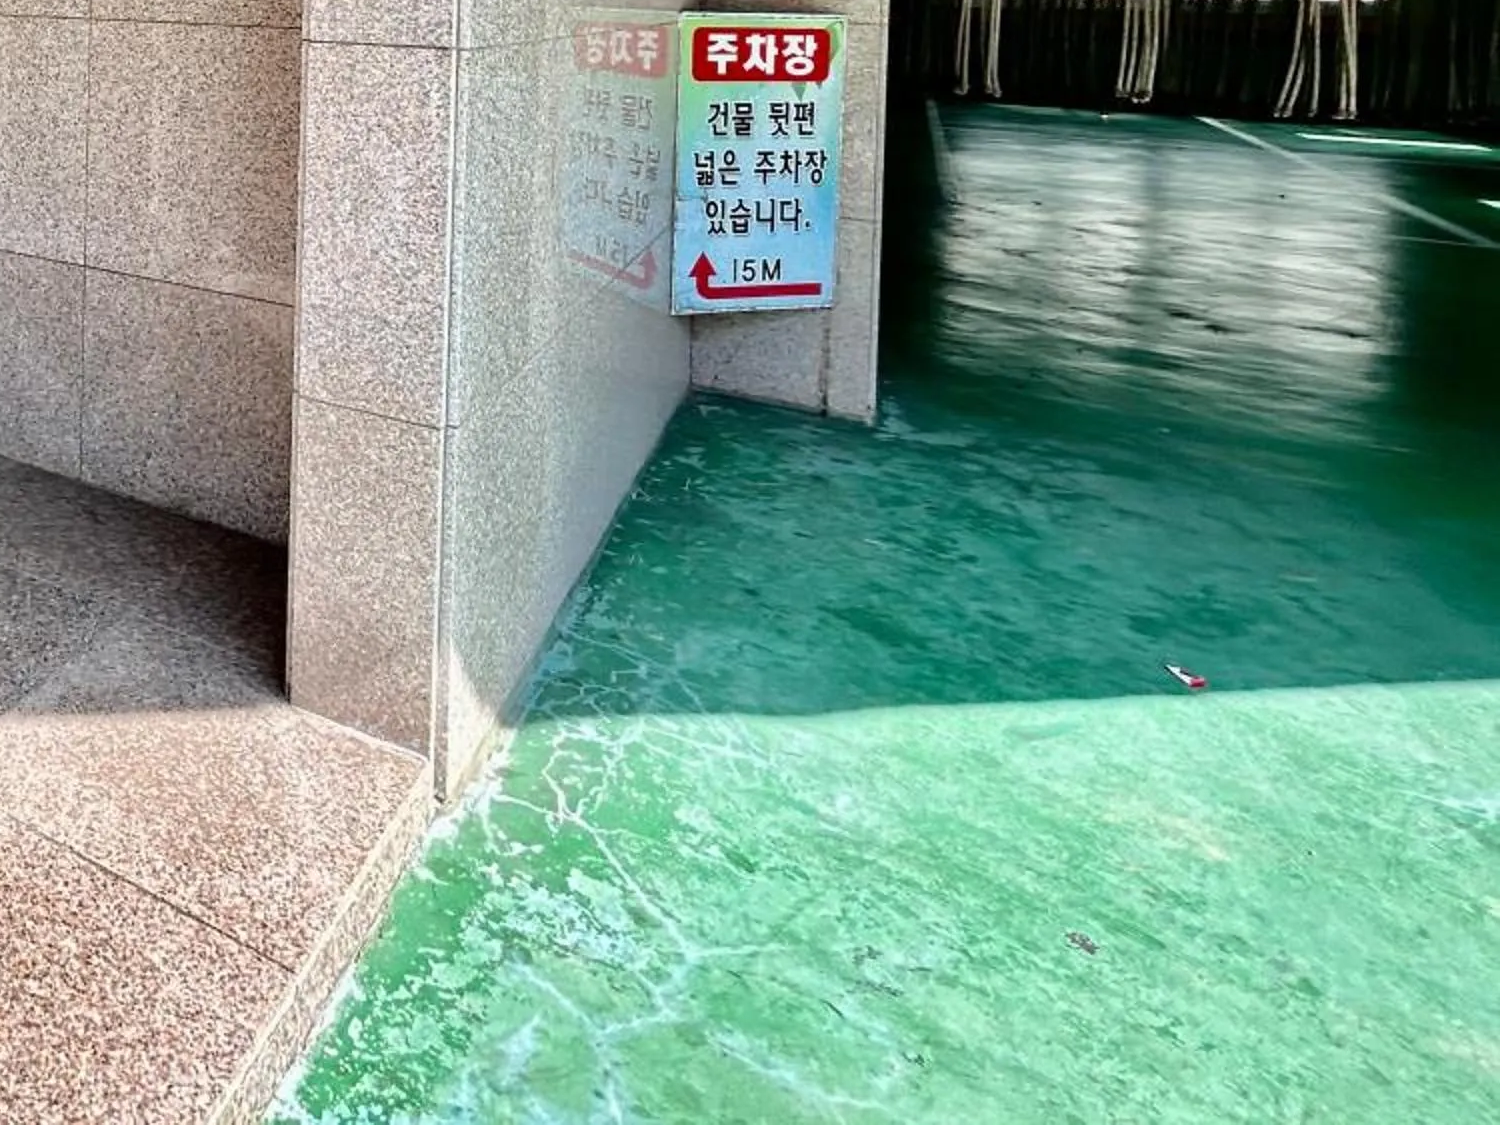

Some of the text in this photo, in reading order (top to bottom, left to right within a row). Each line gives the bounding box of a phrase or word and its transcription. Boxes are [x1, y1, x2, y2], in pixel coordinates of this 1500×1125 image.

[706, 33, 818, 75] 주차장
[707, 101, 816, 137] 건물 뒷편
[694, 150, 827, 186] 넓은 주차장
[705, 199, 812, 235] 있습니다.
[732, 258, 782, 283] 15M
